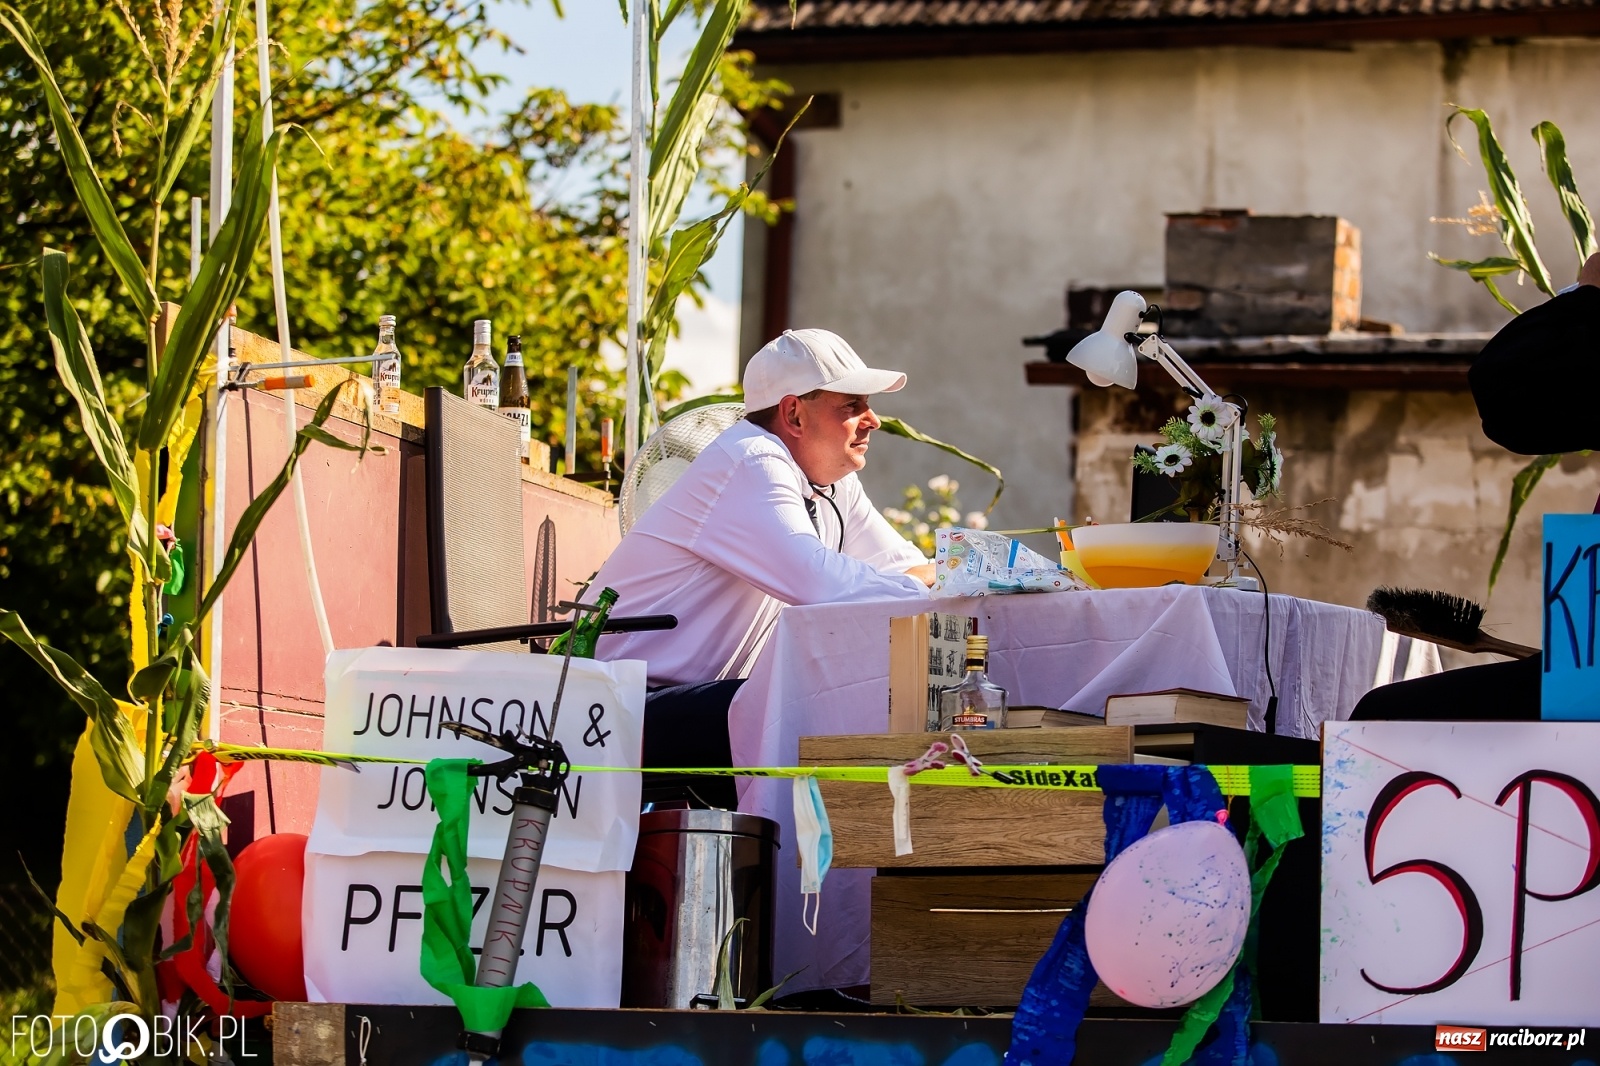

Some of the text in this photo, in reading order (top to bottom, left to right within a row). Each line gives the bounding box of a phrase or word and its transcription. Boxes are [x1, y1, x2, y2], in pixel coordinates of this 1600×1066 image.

[353, 692, 612, 747] JOHNSON &
[377, 766, 582, 820] JONSN
[341, 884, 577, 957] PFZR
